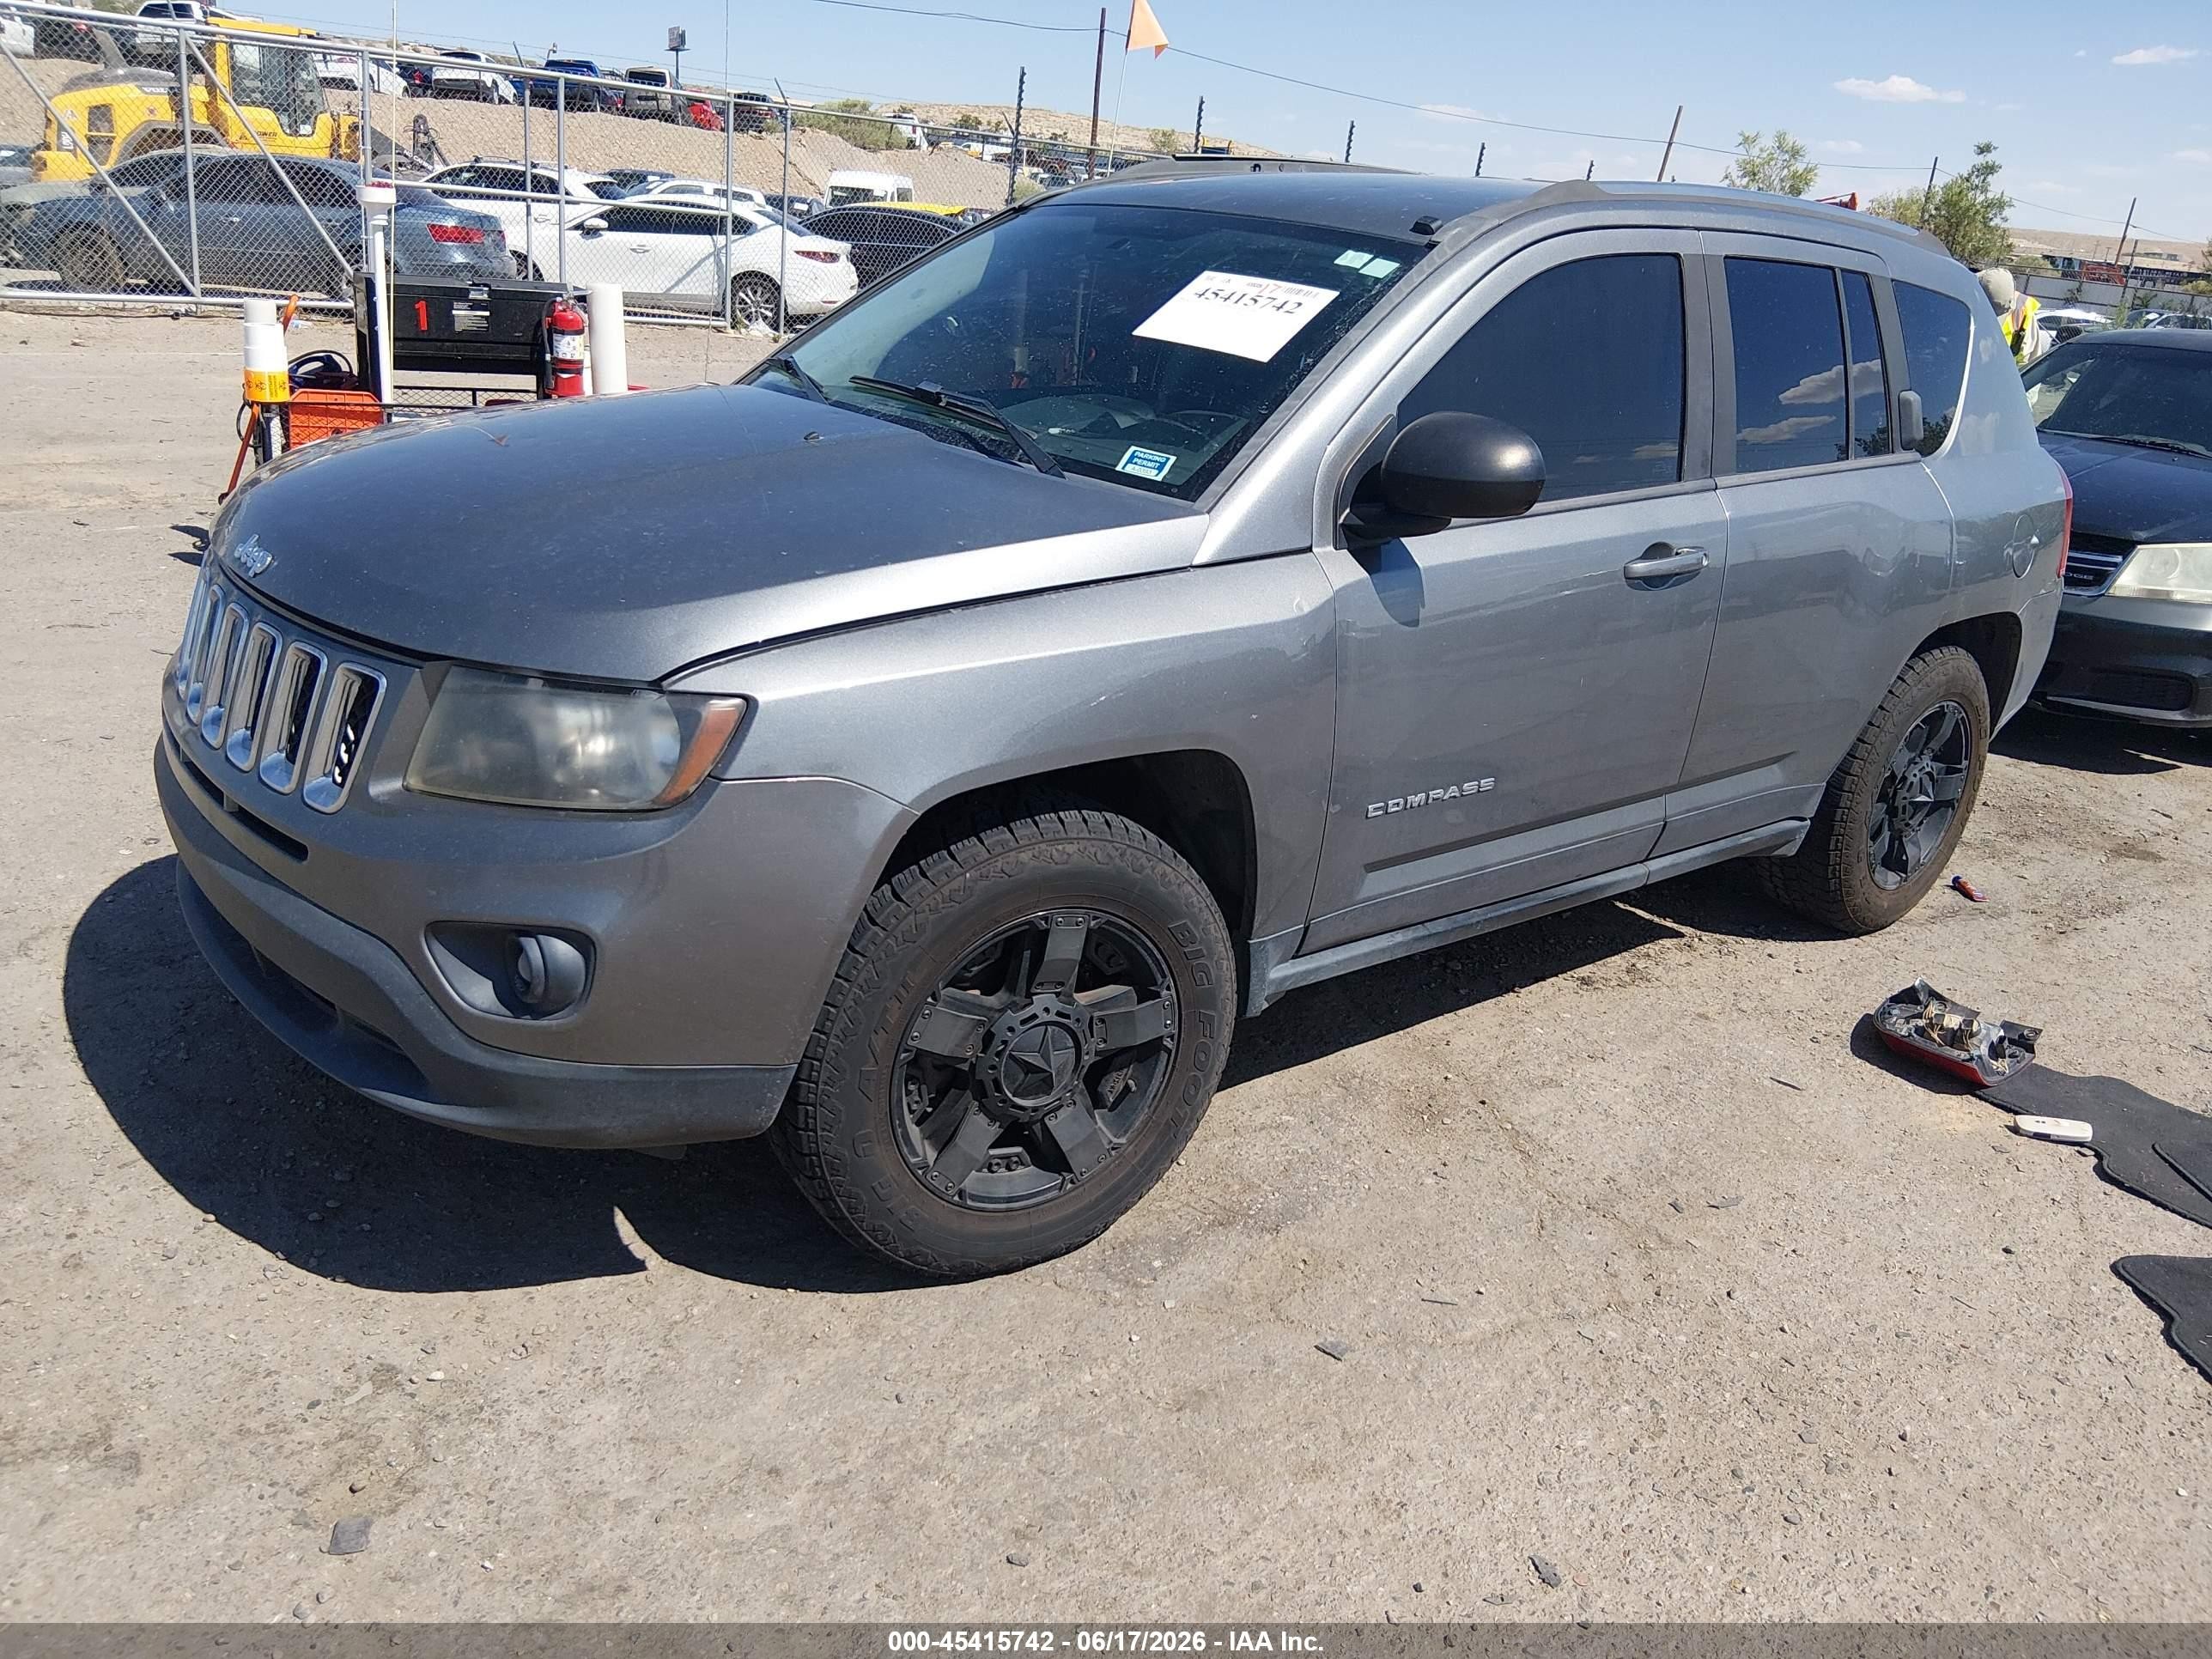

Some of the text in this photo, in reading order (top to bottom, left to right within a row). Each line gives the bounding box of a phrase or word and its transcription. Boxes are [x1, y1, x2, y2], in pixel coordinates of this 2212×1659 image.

[1194, 288, 1303, 314] 45415742
[414, 300, 428, 331] 1
[1132, 457, 1161, 469] PERMIT
[1133, 451, 1167, 463] PARKING
[234, 533, 273, 578] Jeep
[1366, 777, 1496, 819] COMPASS
